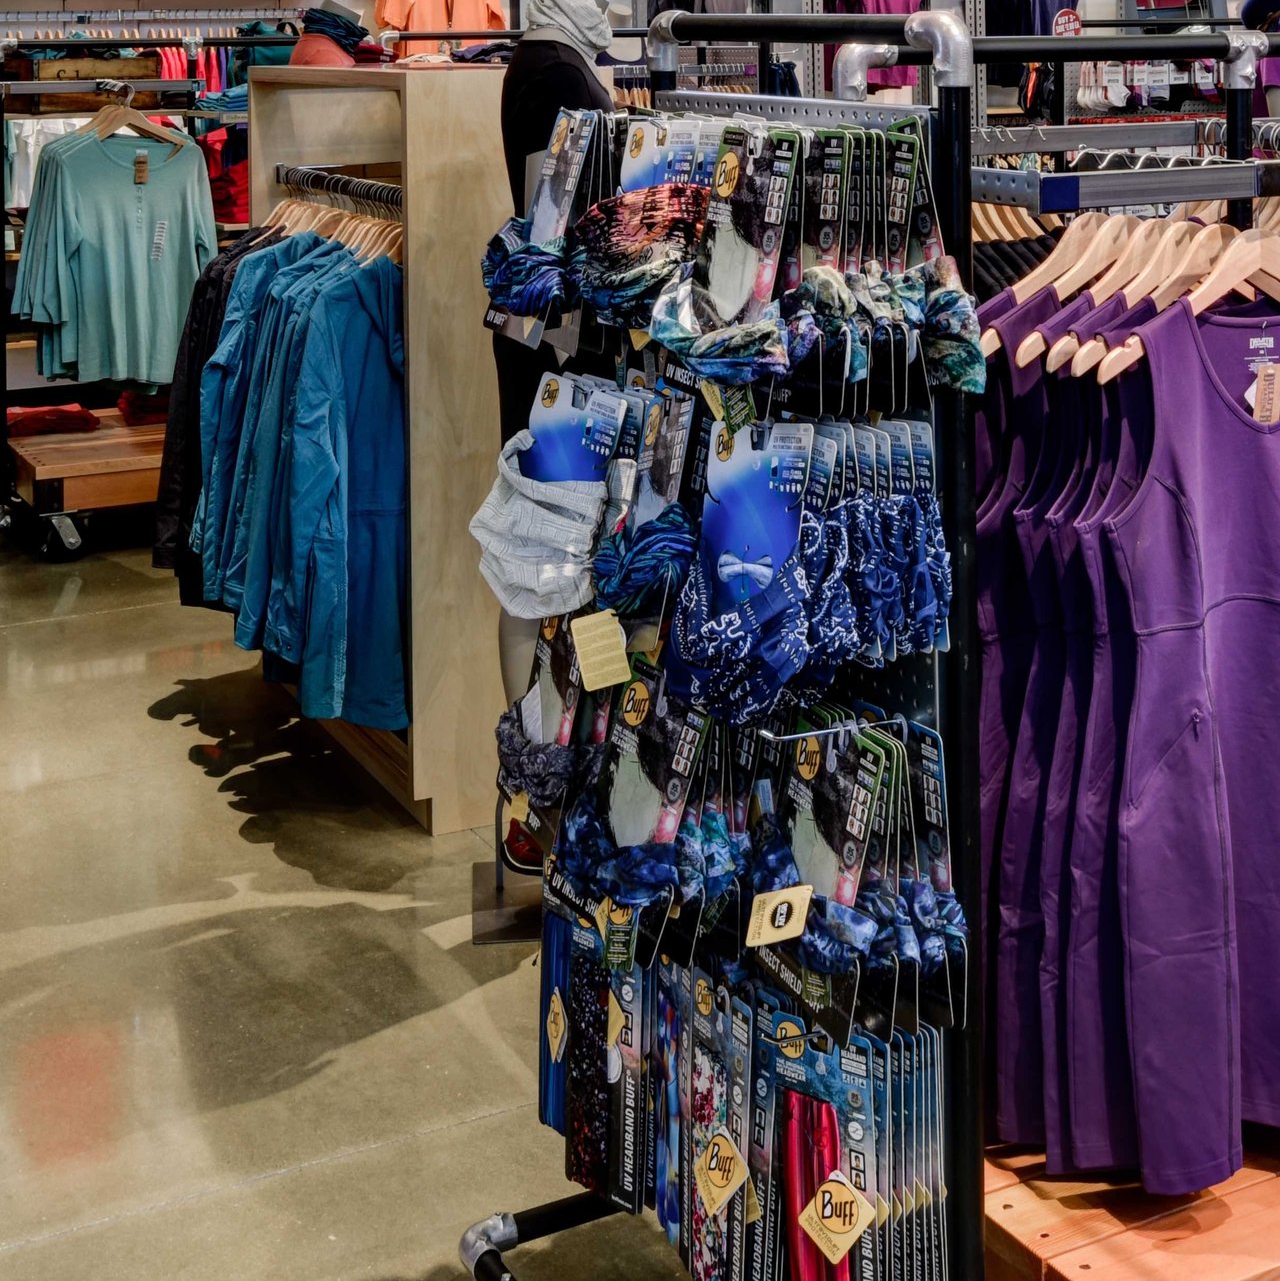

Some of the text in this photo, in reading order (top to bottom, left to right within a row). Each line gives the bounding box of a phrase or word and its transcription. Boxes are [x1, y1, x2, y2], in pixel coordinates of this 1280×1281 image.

[666, 366, 674, 379] UV
[673, 368, 695, 386] INSECT
[552, 873, 562, 888] UV
[758, 946, 802, 995] INSECT SHIELD
[841, 1049, 867, 1064] HEADBAND
[776, 1068, 806, 1082] HEADWEAR
[624, 1070, 635, 1192] UV HEADBAND BUFF®
